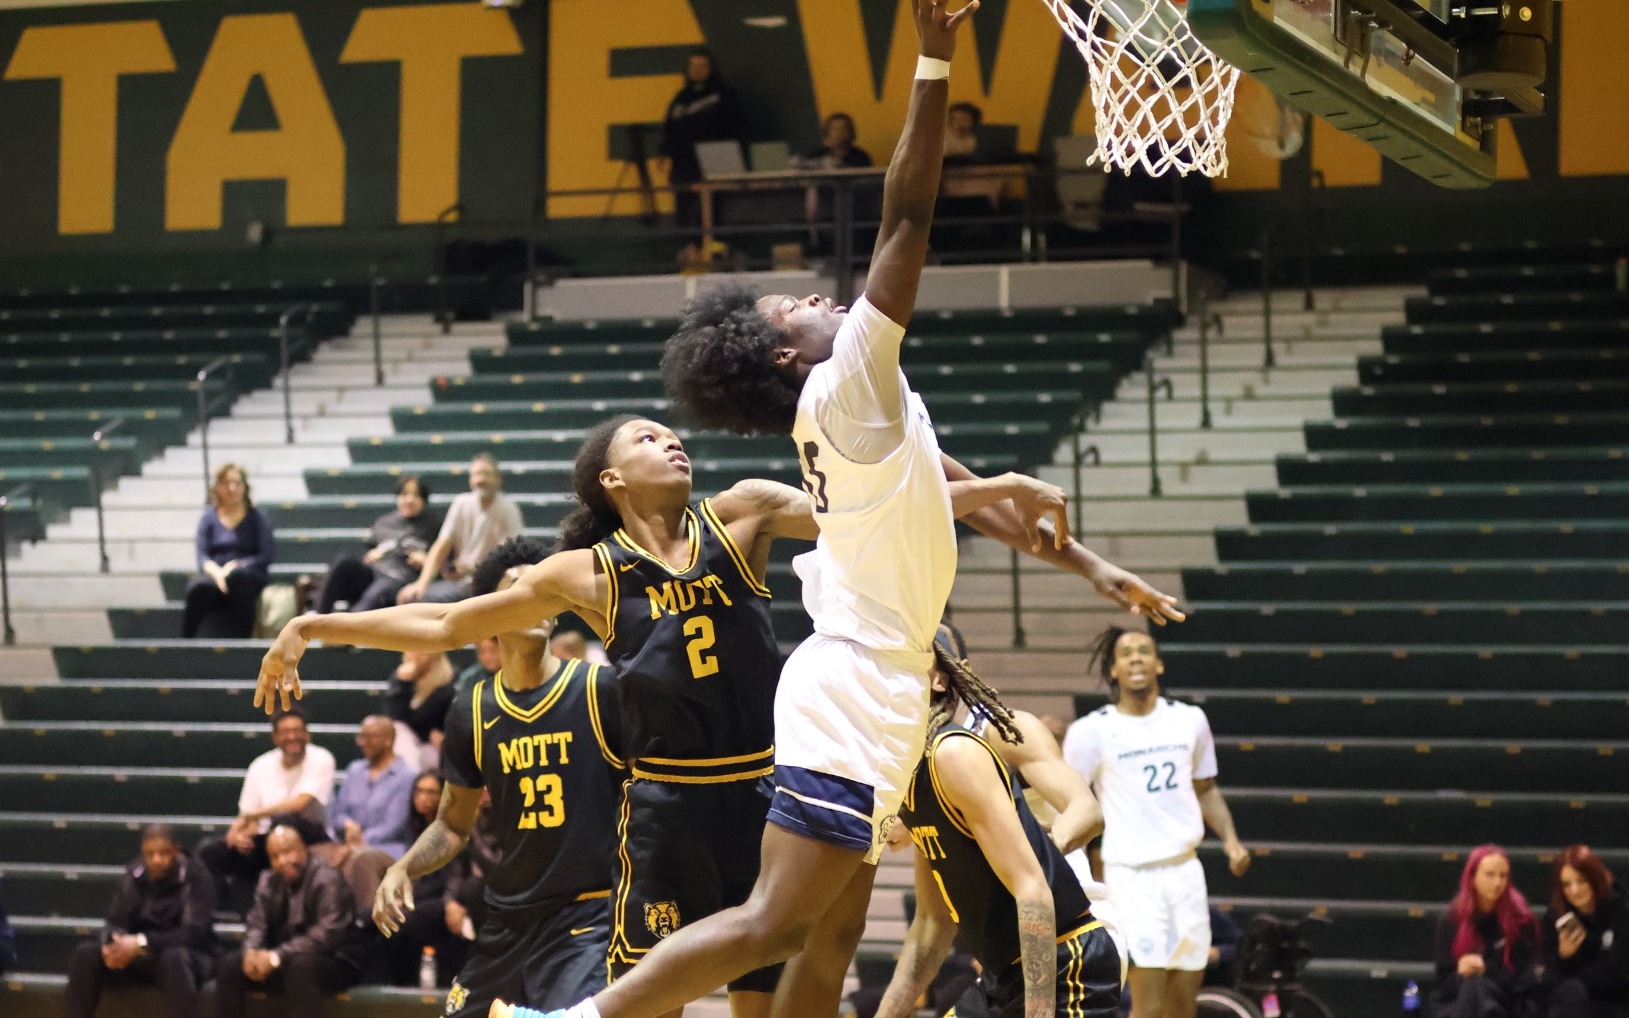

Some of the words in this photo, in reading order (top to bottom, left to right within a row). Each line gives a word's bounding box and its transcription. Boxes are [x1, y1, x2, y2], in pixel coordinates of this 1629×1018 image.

[645, 574, 733, 620] MOTT
[683, 615, 719, 679] 2
[497, 731, 573, 774] MOTT
[1143, 761, 1179, 793] 22
[518, 773, 566, 830] 23
[909, 825, 947, 860] OTT
